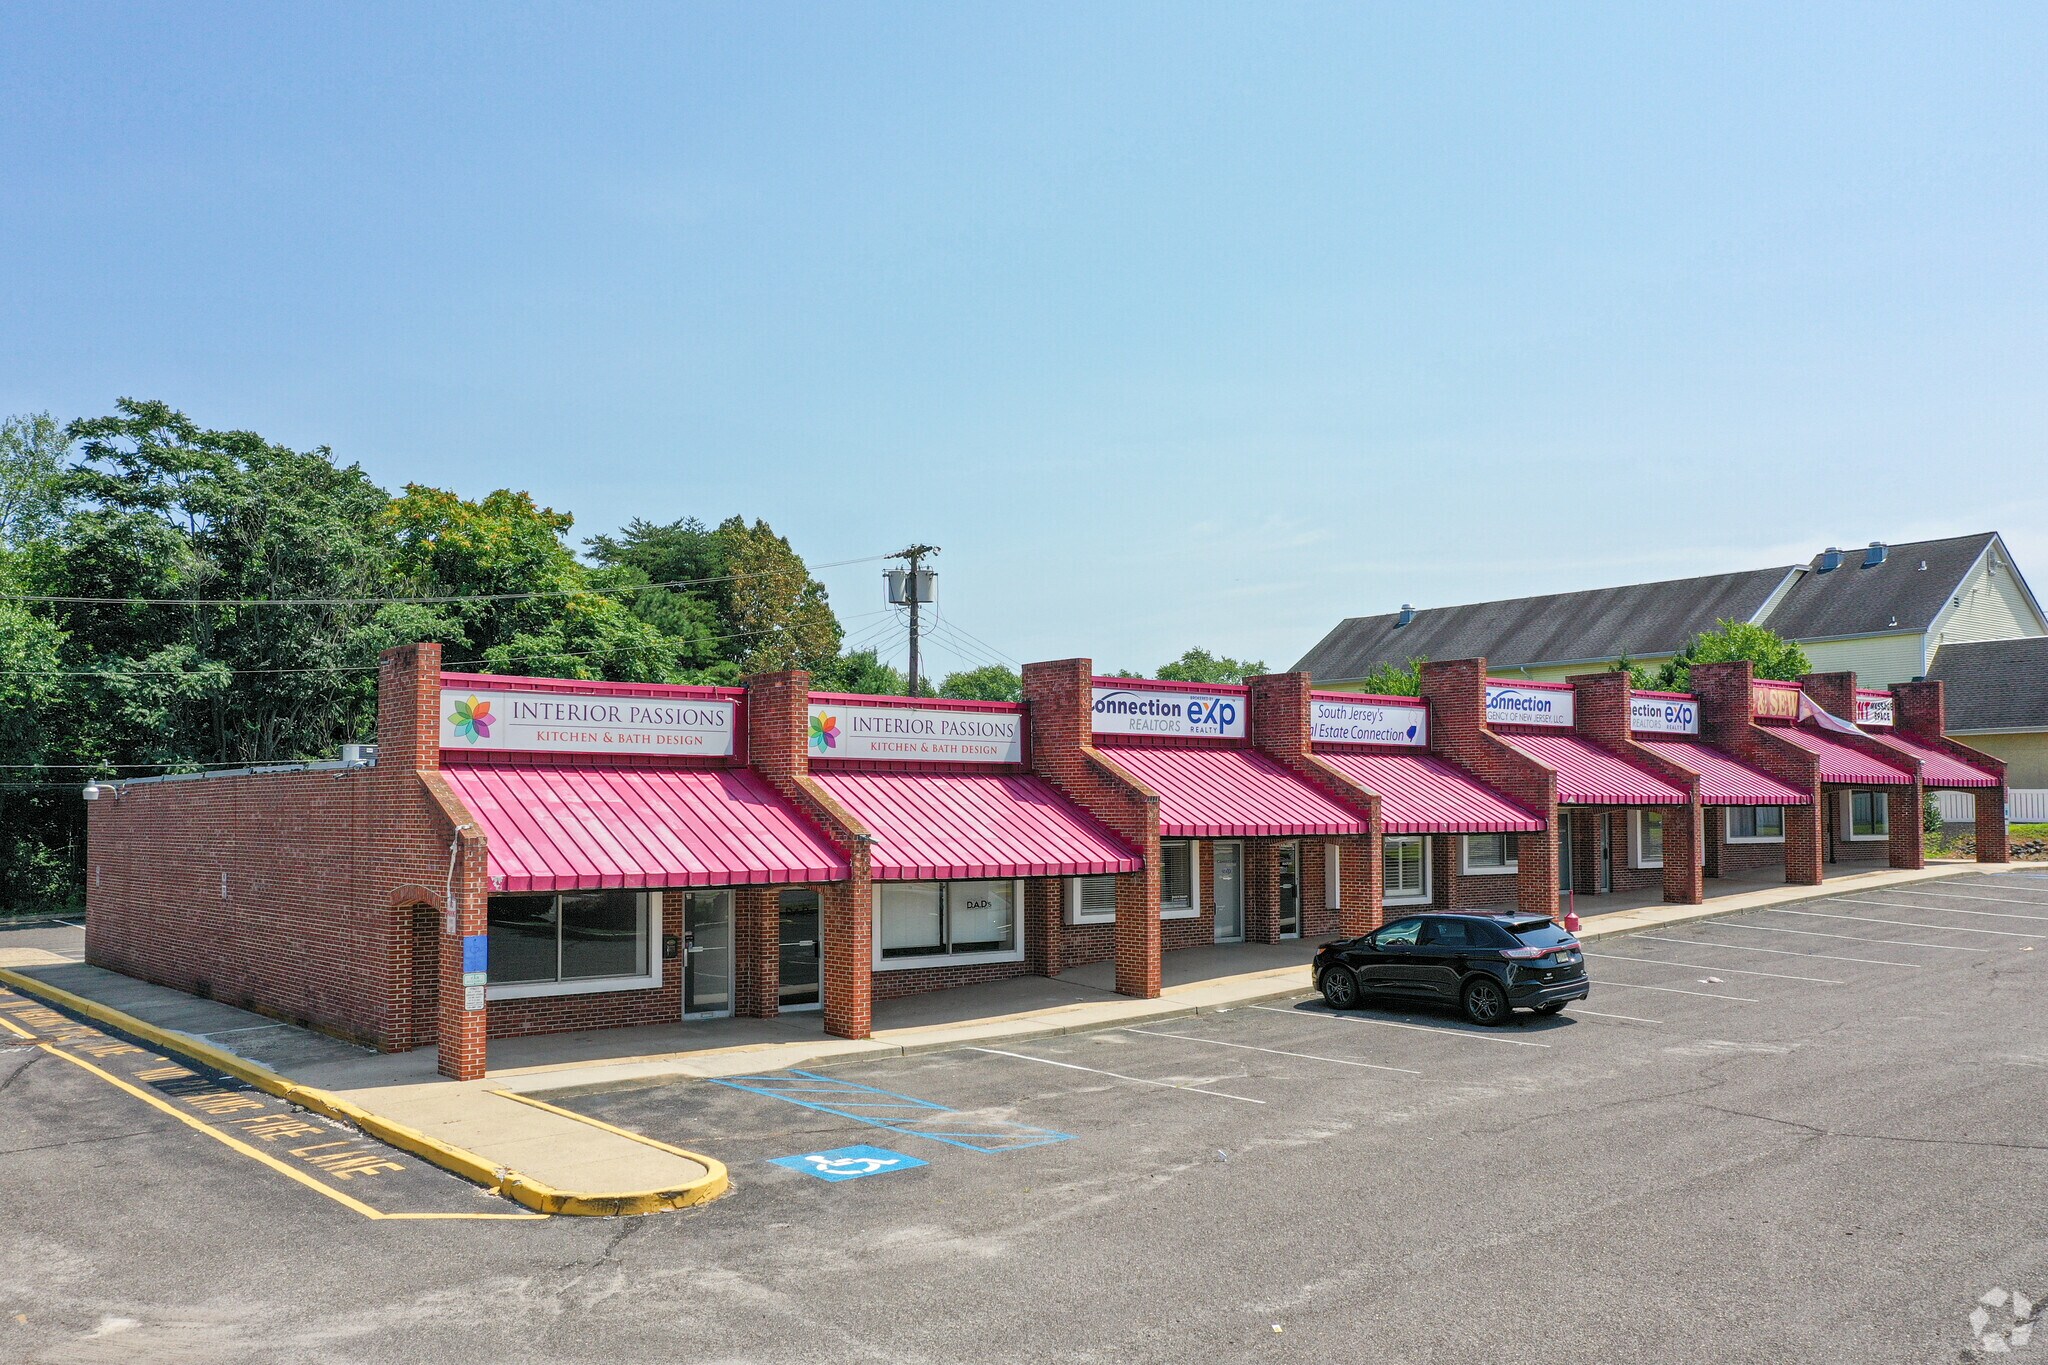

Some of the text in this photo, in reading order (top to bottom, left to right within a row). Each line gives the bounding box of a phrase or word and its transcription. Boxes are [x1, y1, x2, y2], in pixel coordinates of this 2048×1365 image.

[1757, 689, 1798, 717] & SEW
[513, 701, 725, 727] INTERIOR PASSIONS
[1318, 704, 1384, 725] South Jersey's
[1486, 711, 1509, 721] GENCY
[1510, 713, 1518, 721] OF
[1519, 713, 1532, 722] NEW
[1553, 715, 1564, 724] LLC
[853, 716, 1014, 738] INTERIOR PASSIONS
[1129, 718, 1181, 732] REALTORS
[1190, 726, 1218, 734] REALTY
[1633, 718, 1661, 729] REALTORS
[537, 731, 704, 746] KITCHEN & BATH DESIGN
[1319, 724, 1349, 739] Estate
[1350, 725, 1404, 741] Connection
[871, 741, 998, 755] KITCHEN & BATH DESIGN
[228, 1113, 327, 1142] FIRE
[288, 1141, 406, 1180] LANE
